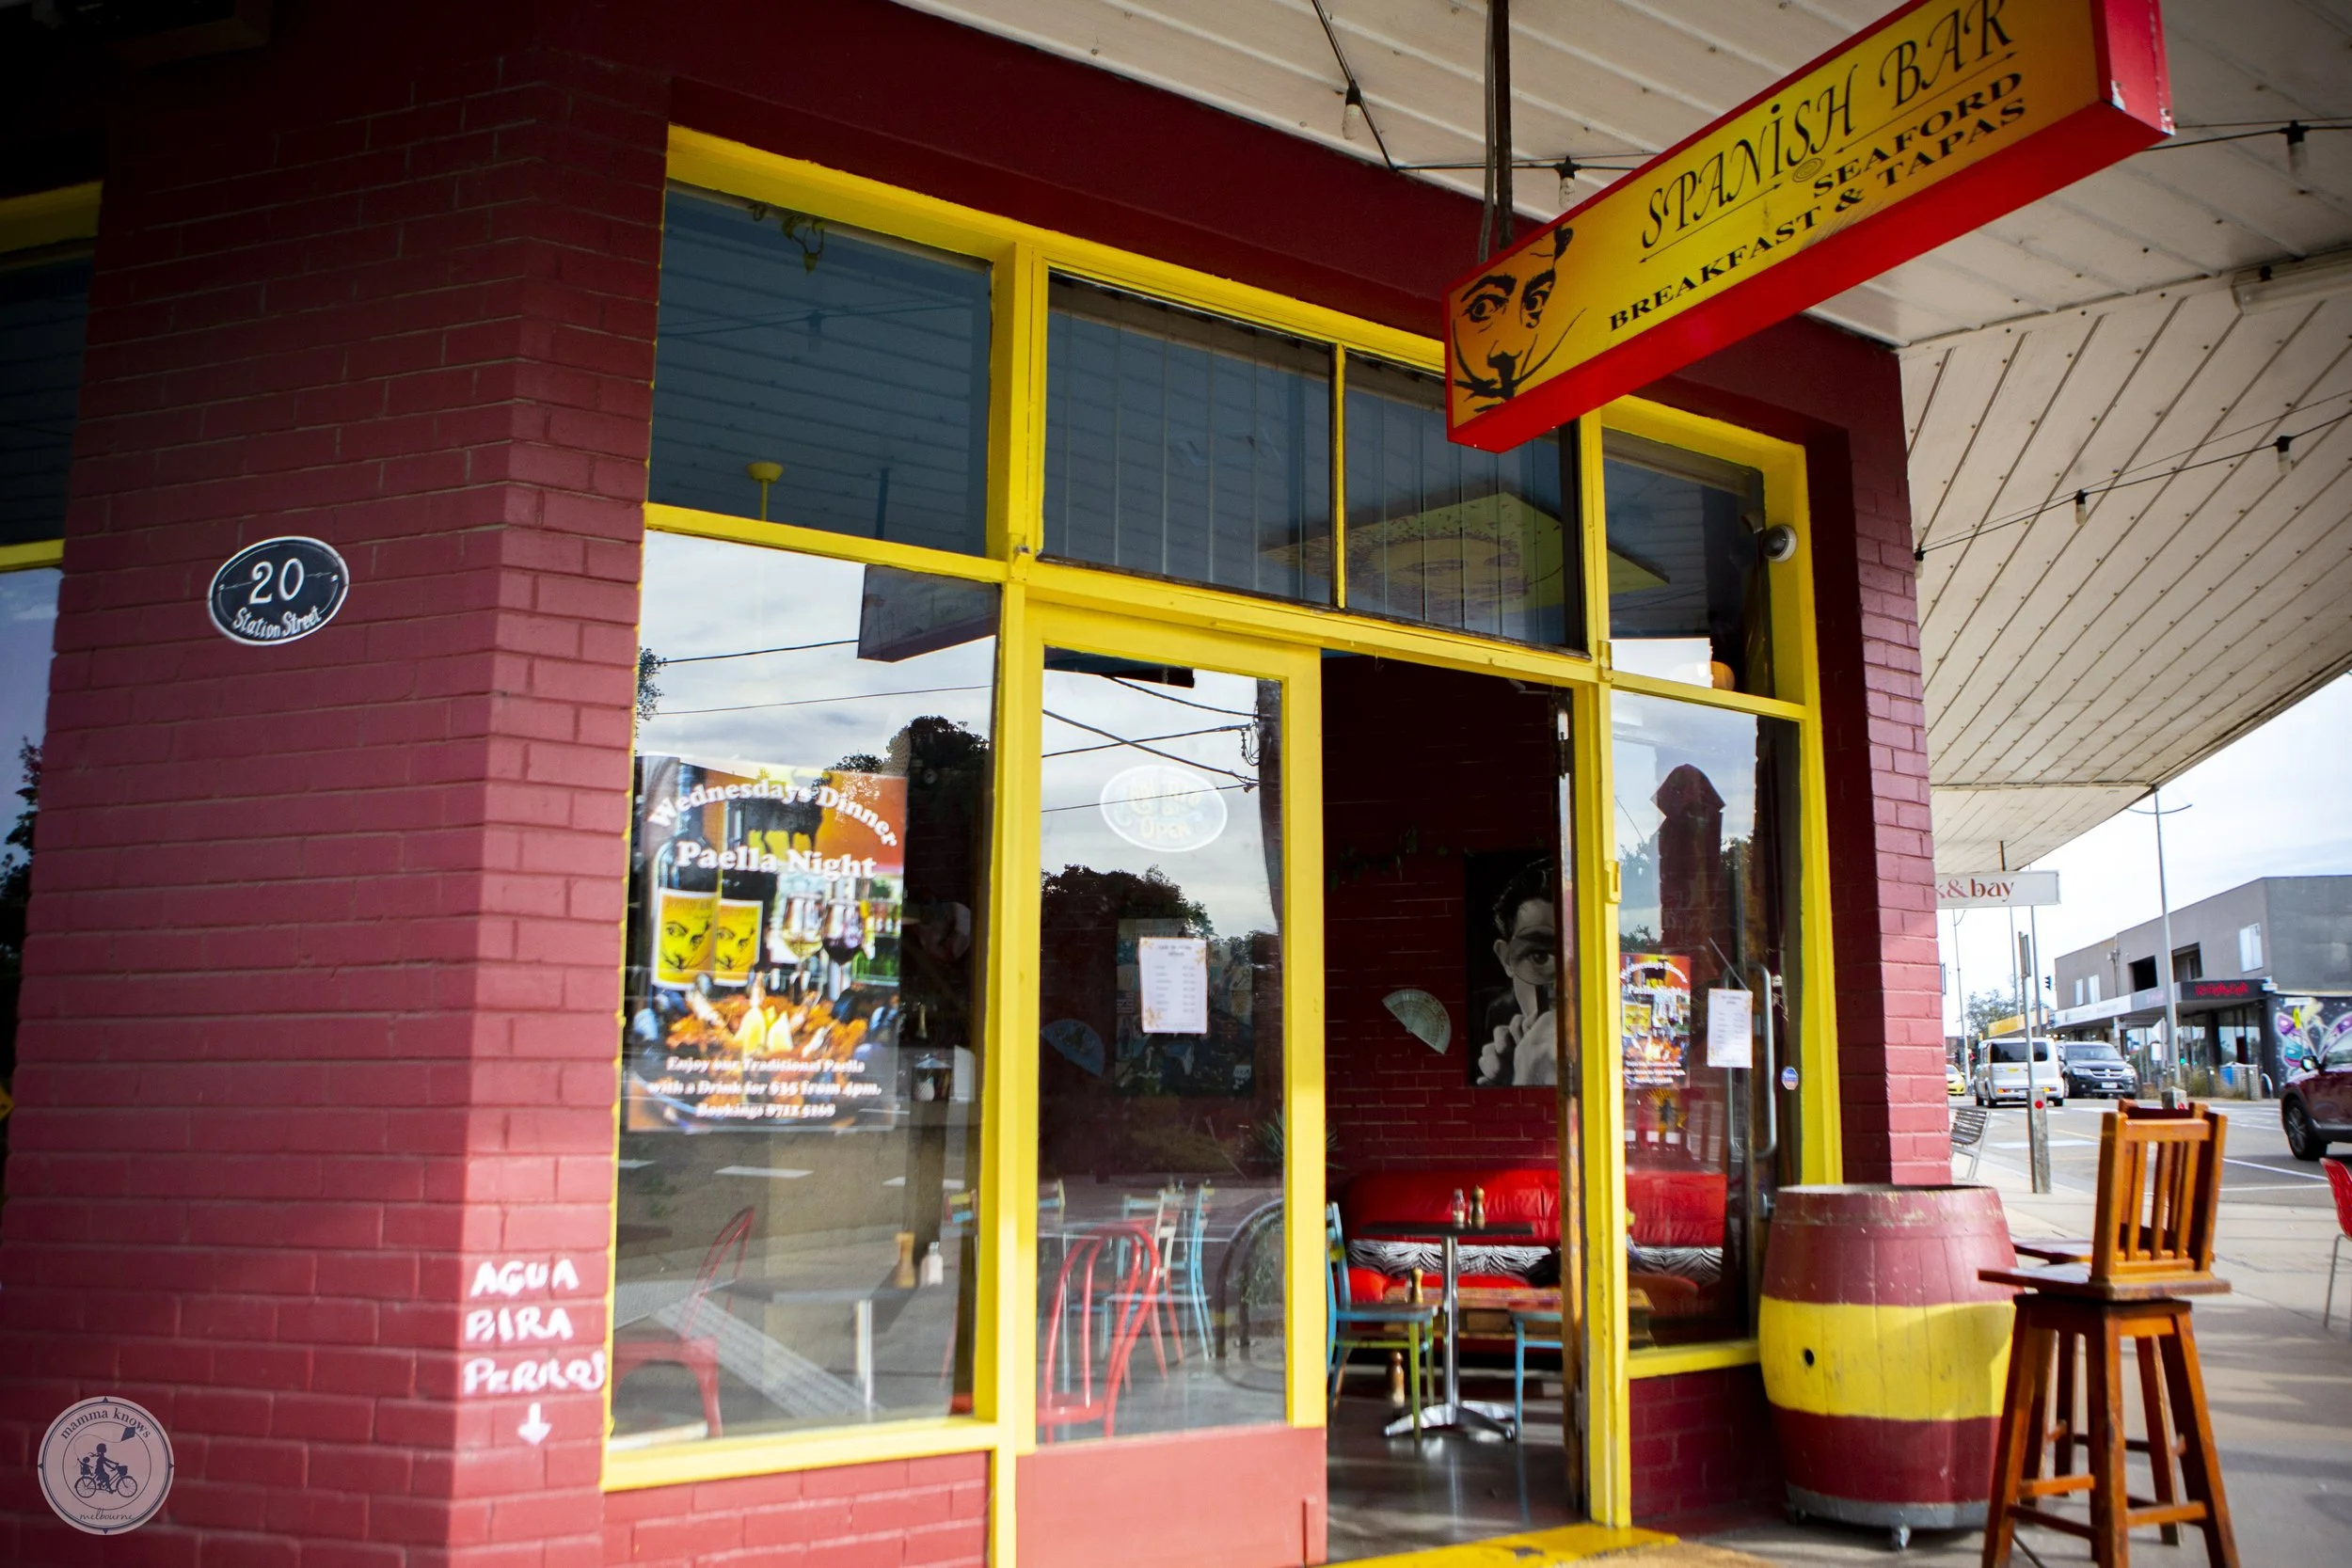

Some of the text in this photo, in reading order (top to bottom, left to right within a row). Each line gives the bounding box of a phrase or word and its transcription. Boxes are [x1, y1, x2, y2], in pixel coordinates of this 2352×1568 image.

[1879, 0, 2013, 110] BAR
[1813, 72, 2022, 198] SEAFORD
[1608, 98, 2026, 332] BREAKFAST & TAPAS
[248, 558, 305, 605] 20
[232, 604, 322, 641] Station Street
[647, 780, 898, 847] Wednesdays Dinner
[675, 840, 877, 882] Paella Night
[666, 1056, 866, 1074] Enjoy our Traditional Paella
[801, 1080, 841, 1095] from
[469, 1259, 580, 1298] AGUA
